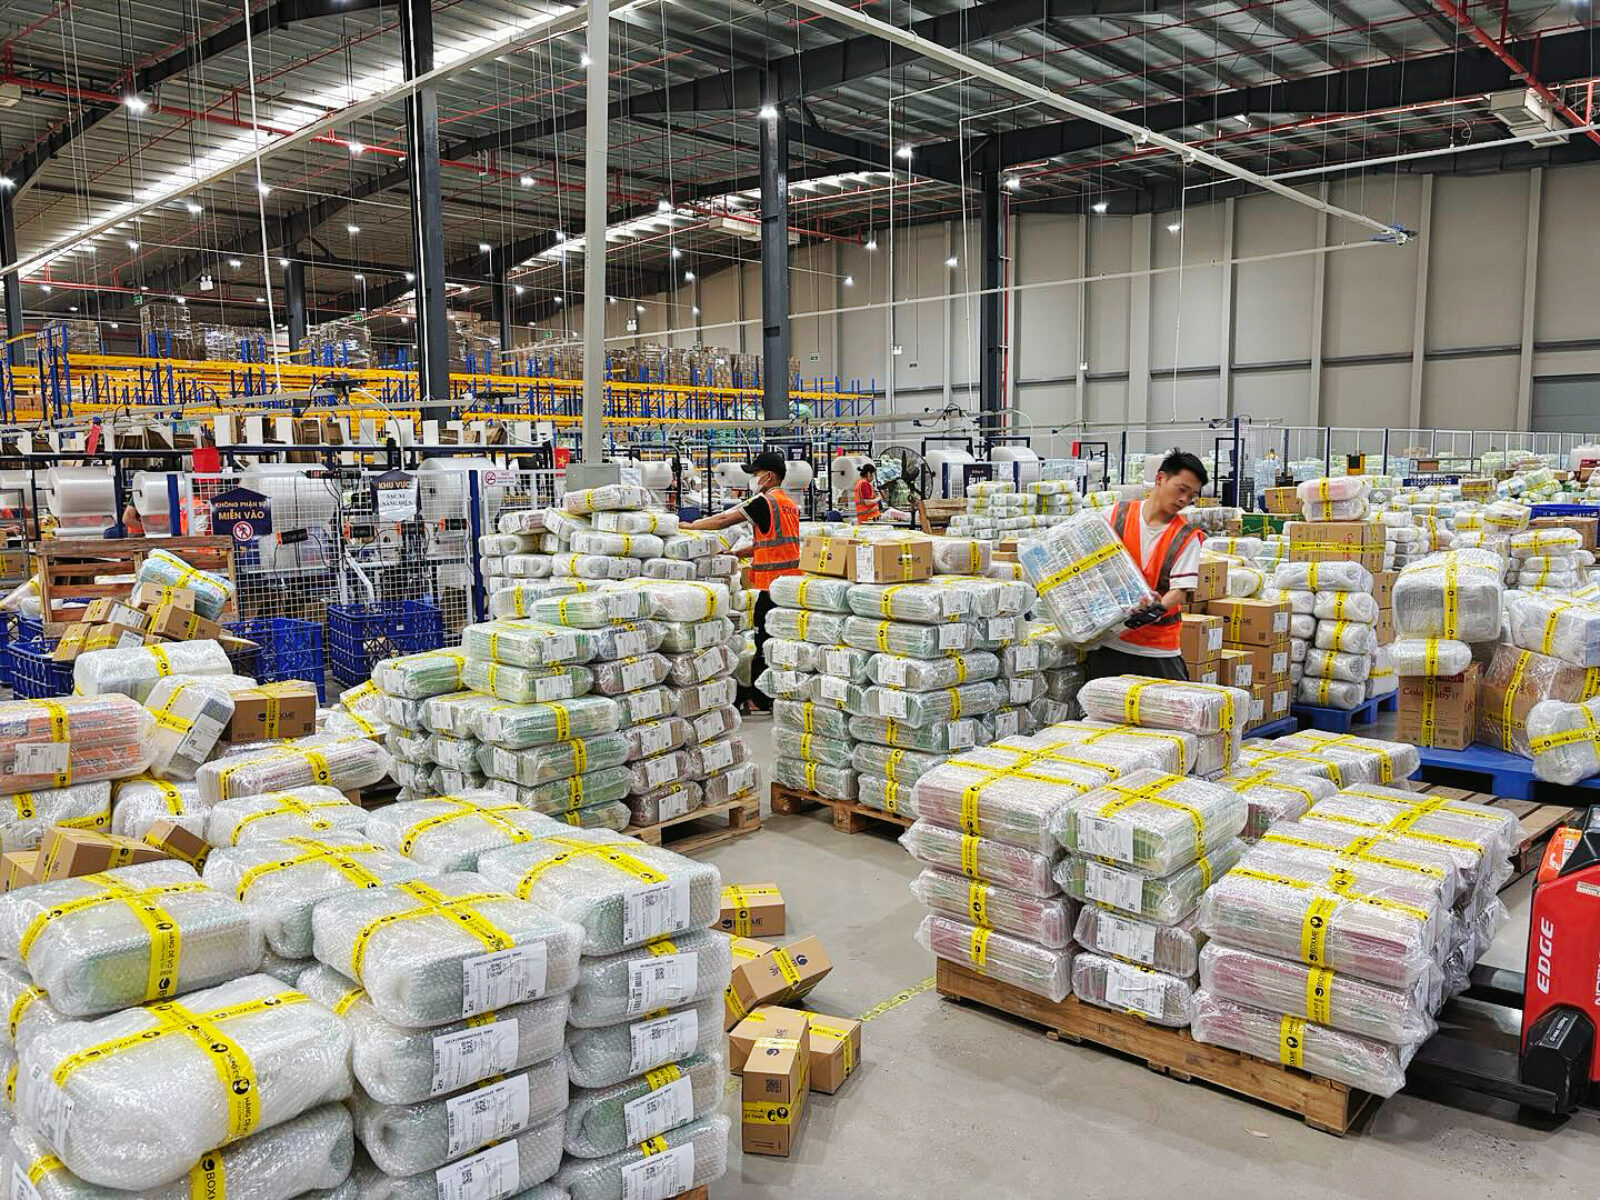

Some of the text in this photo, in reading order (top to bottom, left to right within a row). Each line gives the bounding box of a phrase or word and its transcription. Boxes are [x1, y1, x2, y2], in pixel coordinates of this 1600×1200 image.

[378, 481, 394, 489] KHU
[243, 509, 265, 520] VÀO
[1537, 917, 1554, 995] EDGE
